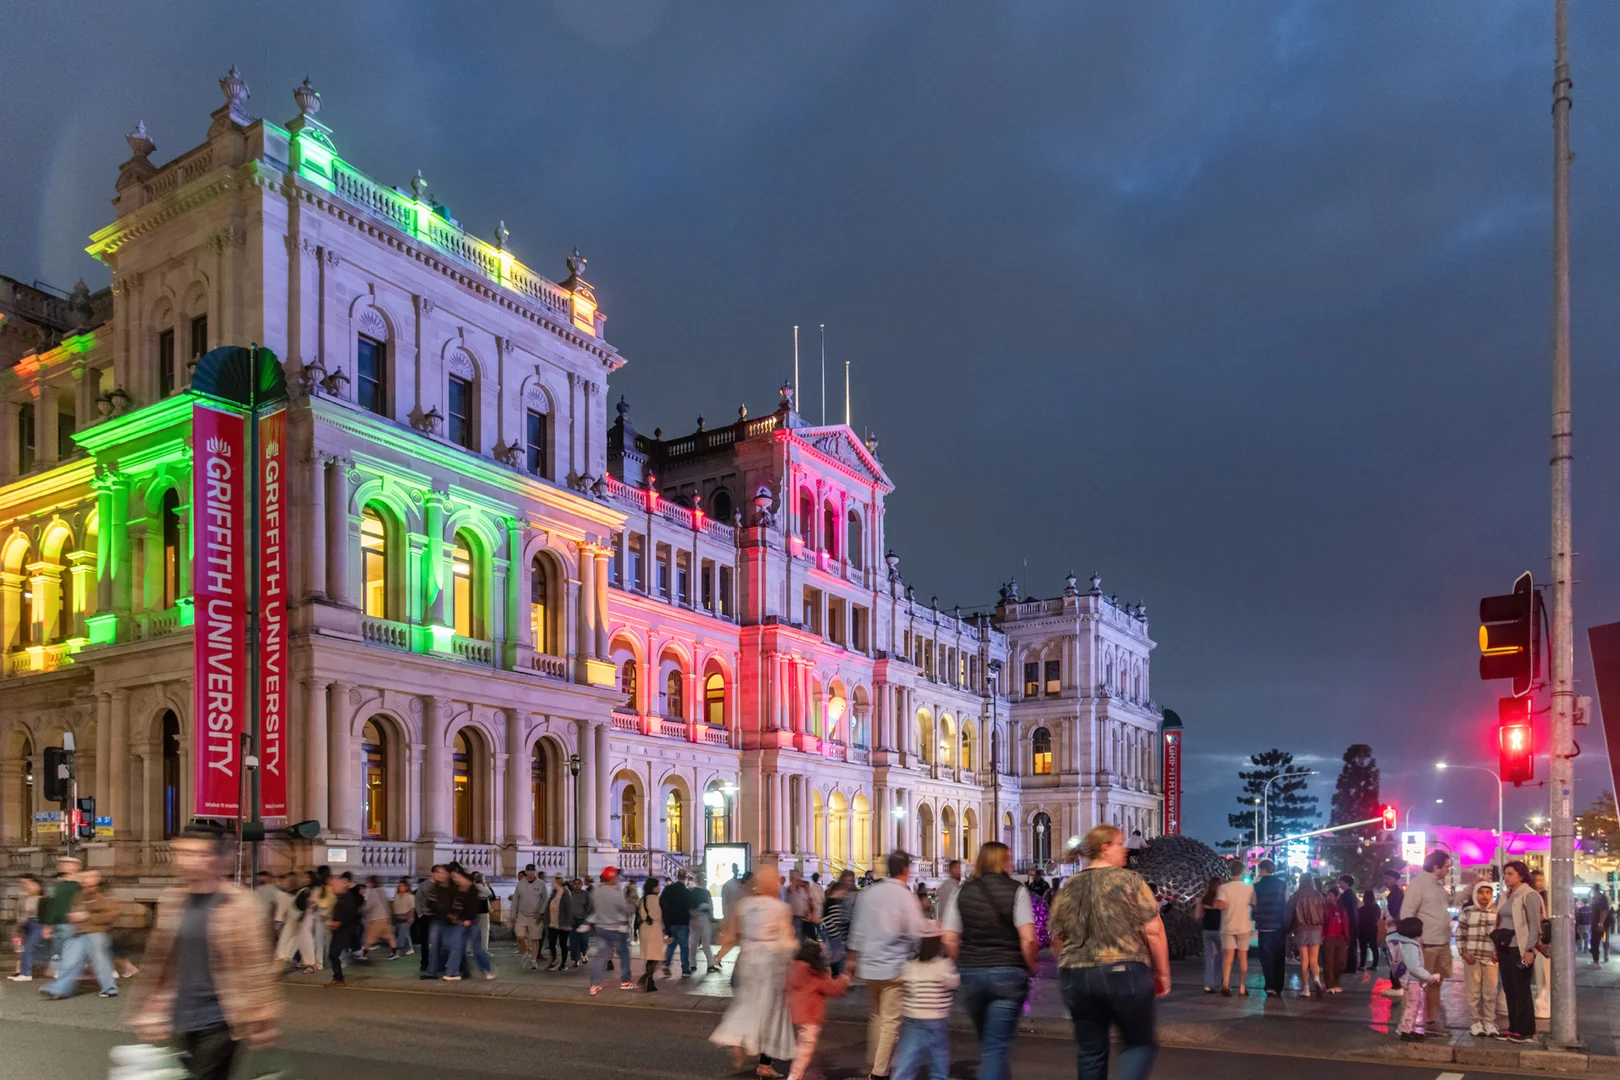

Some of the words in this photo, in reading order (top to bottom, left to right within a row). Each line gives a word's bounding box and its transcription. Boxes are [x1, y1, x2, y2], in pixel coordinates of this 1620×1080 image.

[206, 456, 232, 595] GRIFFITH
[265, 460, 280, 596] GRIFFITH
[207, 599, 233, 777] UNIVERSITY
[265, 601, 281, 776] UNIVERSITY
[609, 743, 711, 762] REASURY
[1168, 789, 1177, 836] UNIVERSI
